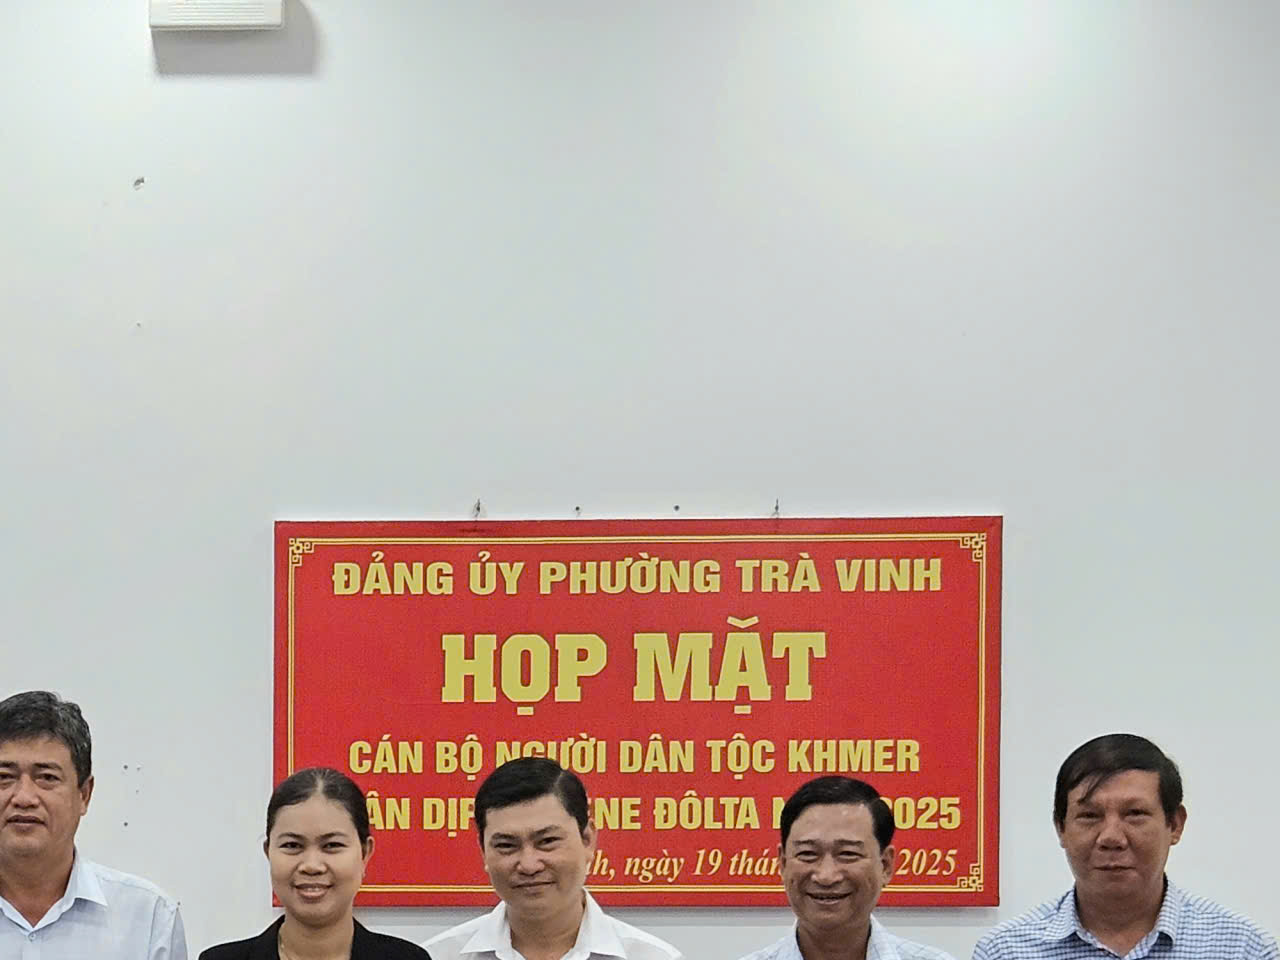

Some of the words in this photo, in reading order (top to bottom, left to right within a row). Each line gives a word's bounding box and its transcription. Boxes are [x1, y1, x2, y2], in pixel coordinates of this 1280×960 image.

[332, 550, 454, 595] ĐẢNG
[469, 550, 525, 595] ỦY
[539, 552, 720, 594] PHƯỜNG
[735, 552, 821, 592] TRÀ
[835, 558, 942, 592] VINH
[441, 633, 607, 715] HỌP
[633, 616, 826, 715] MẶT
[349, 734, 423, 774] CÁN
[435, 734, 483, 781] BỘ
[620, 733, 694, 773] DÂN
[706, 733, 775, 780] TỘC
[787, 739, 920, 773] KHMER
[366, 790, 410, 830] ÂN
[423, 797, 476, 838] DỊP
[587, 797, 641, 830] NE
[653, 790, 760, 830] ĐÔLTA
[880, 796, 961, 830] 025
[623, 850, 683, 883] ngày
[692, 849, 723, 876] 19
[728, 848, 782, 876] thán
[895, 848, 958, 876] 2025
